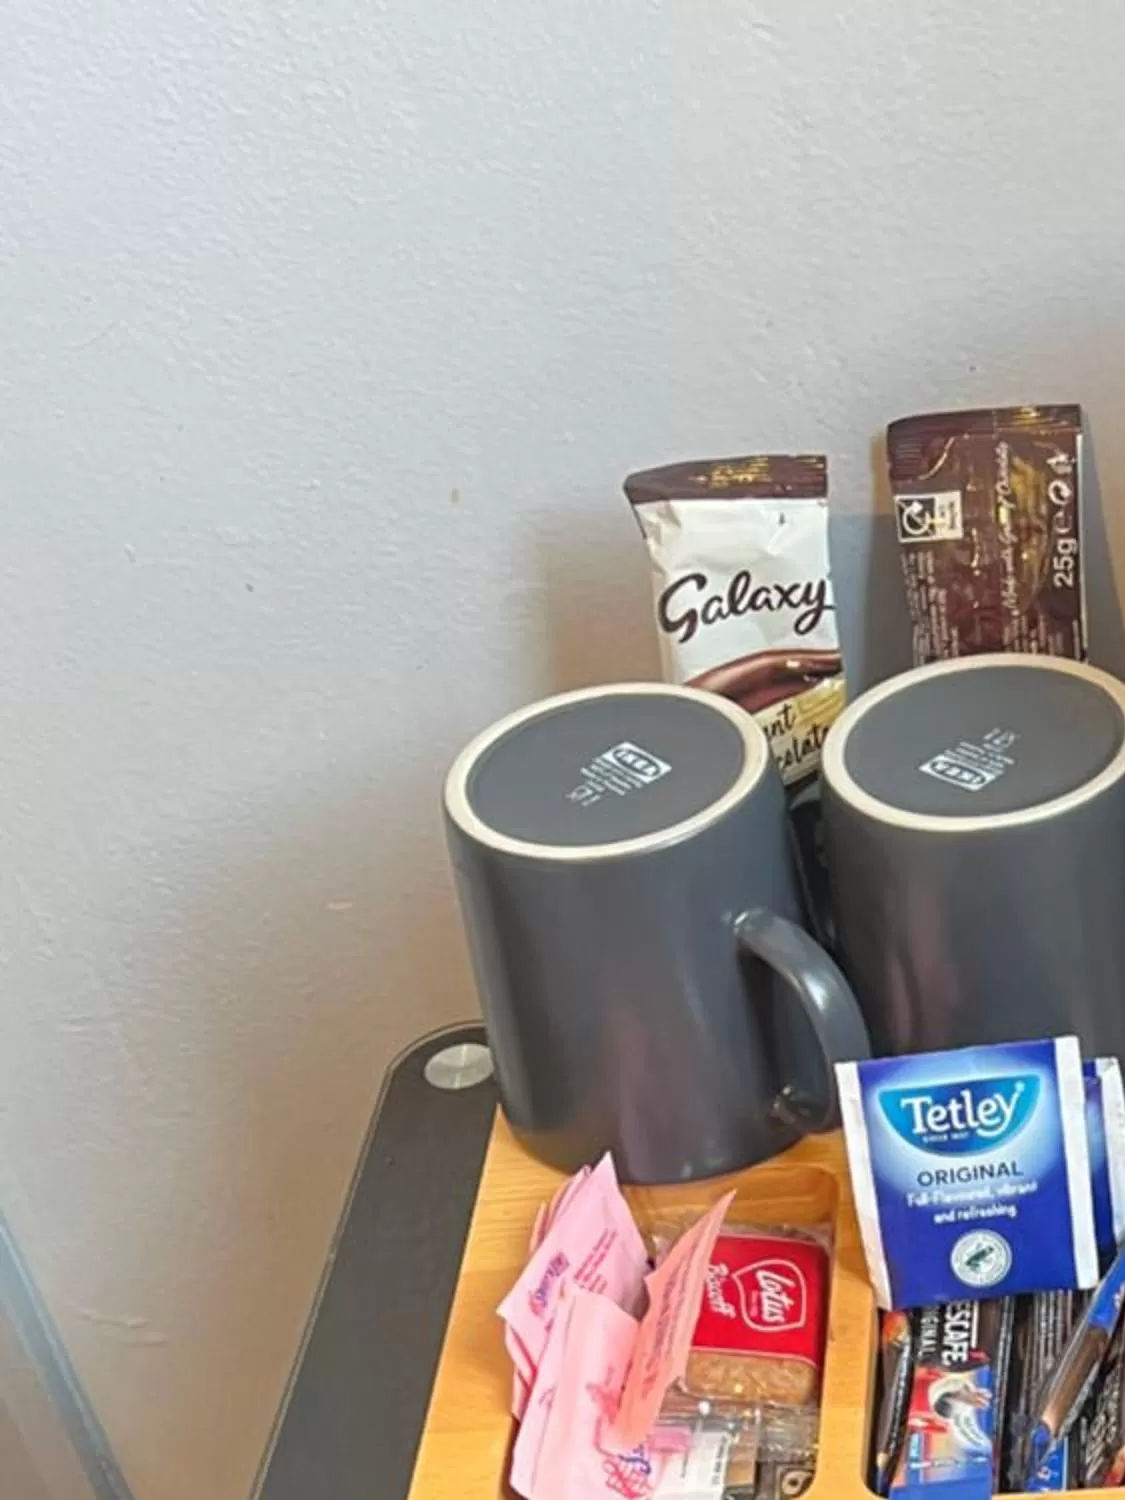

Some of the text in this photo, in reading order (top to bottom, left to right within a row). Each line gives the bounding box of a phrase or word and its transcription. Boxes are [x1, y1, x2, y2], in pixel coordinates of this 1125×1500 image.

[1053, 538, 1077, 588] 25g
[658, 570, 838, 645] Galaxy
[900, 1081, 1025, 1138] Tetley
[916, 1160, 1025, 1187] ORIGINAL
[755, 1269, 795, 1325] Lotus
